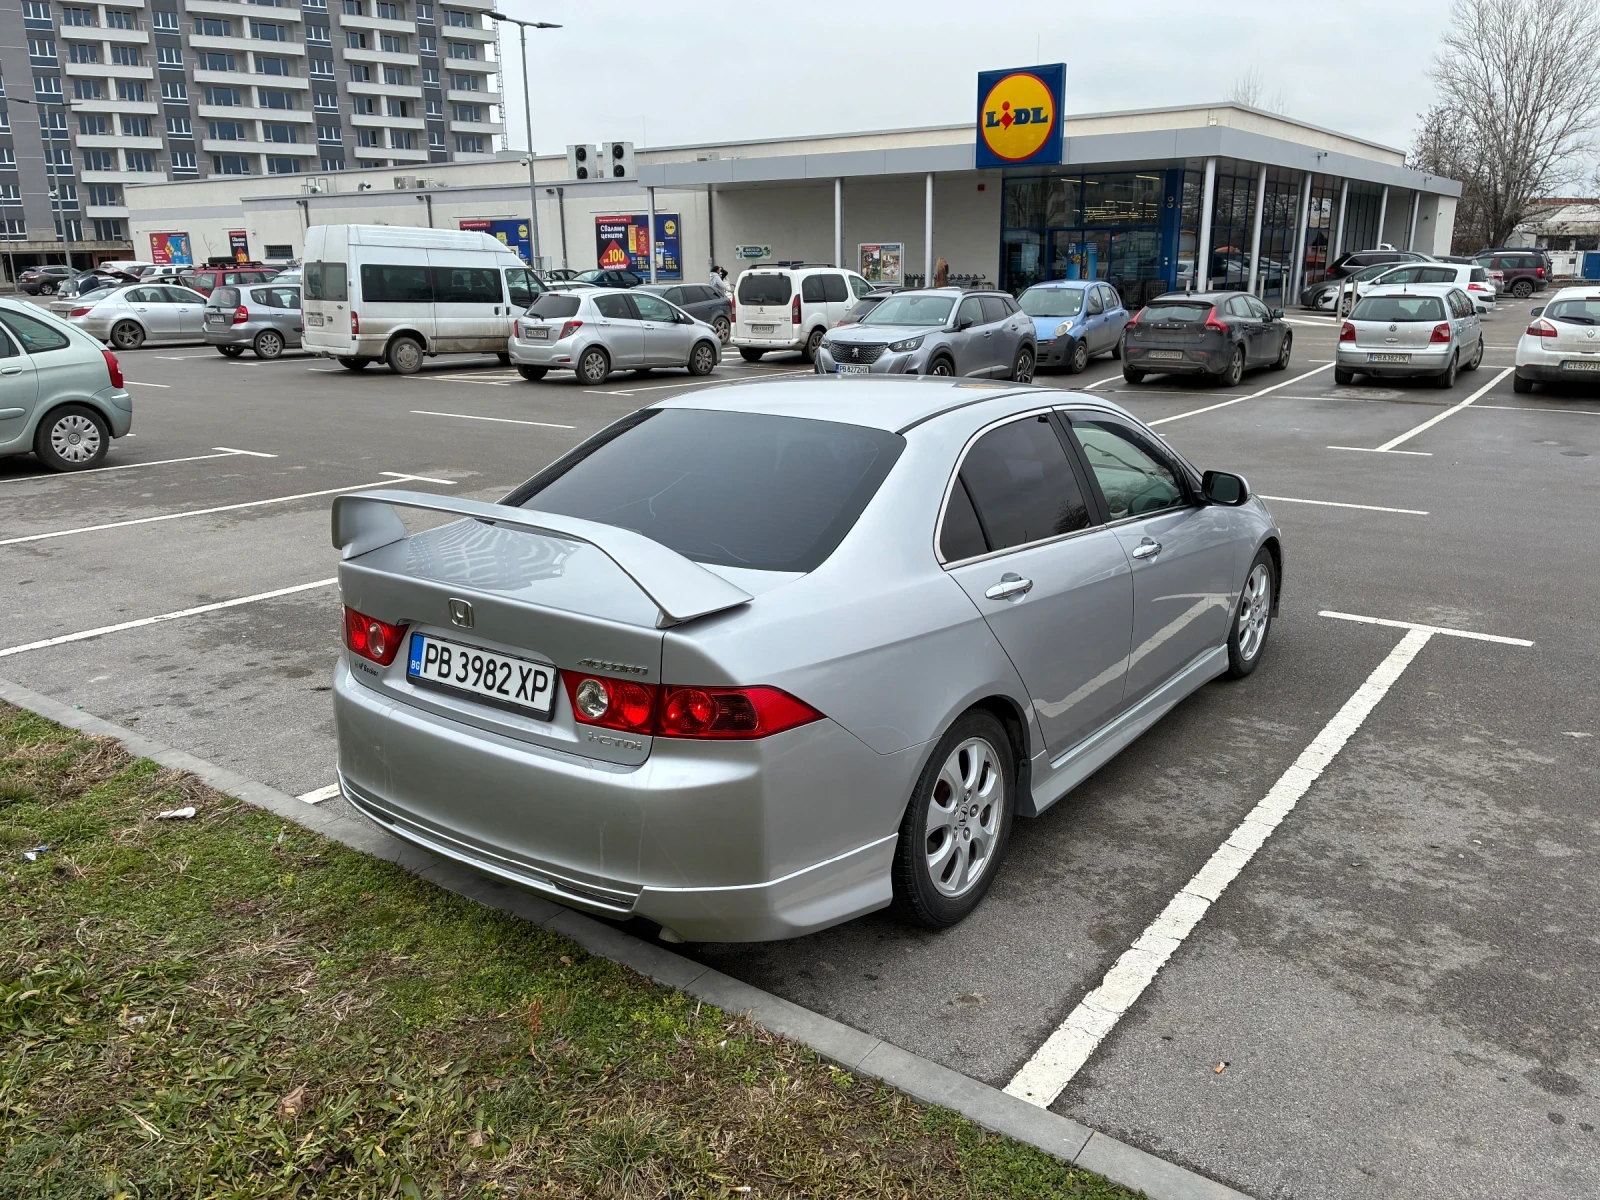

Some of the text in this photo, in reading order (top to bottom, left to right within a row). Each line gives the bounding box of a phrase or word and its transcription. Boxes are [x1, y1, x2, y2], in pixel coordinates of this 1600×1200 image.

[985, 101, 1049, 130] LIDL
[608, 249, 625, 262] 100
[410, 659, 421, 671] BG
[423, 642, 548, 703] PB 3982 XP
[576, 658, 649, 676] ACCORD
